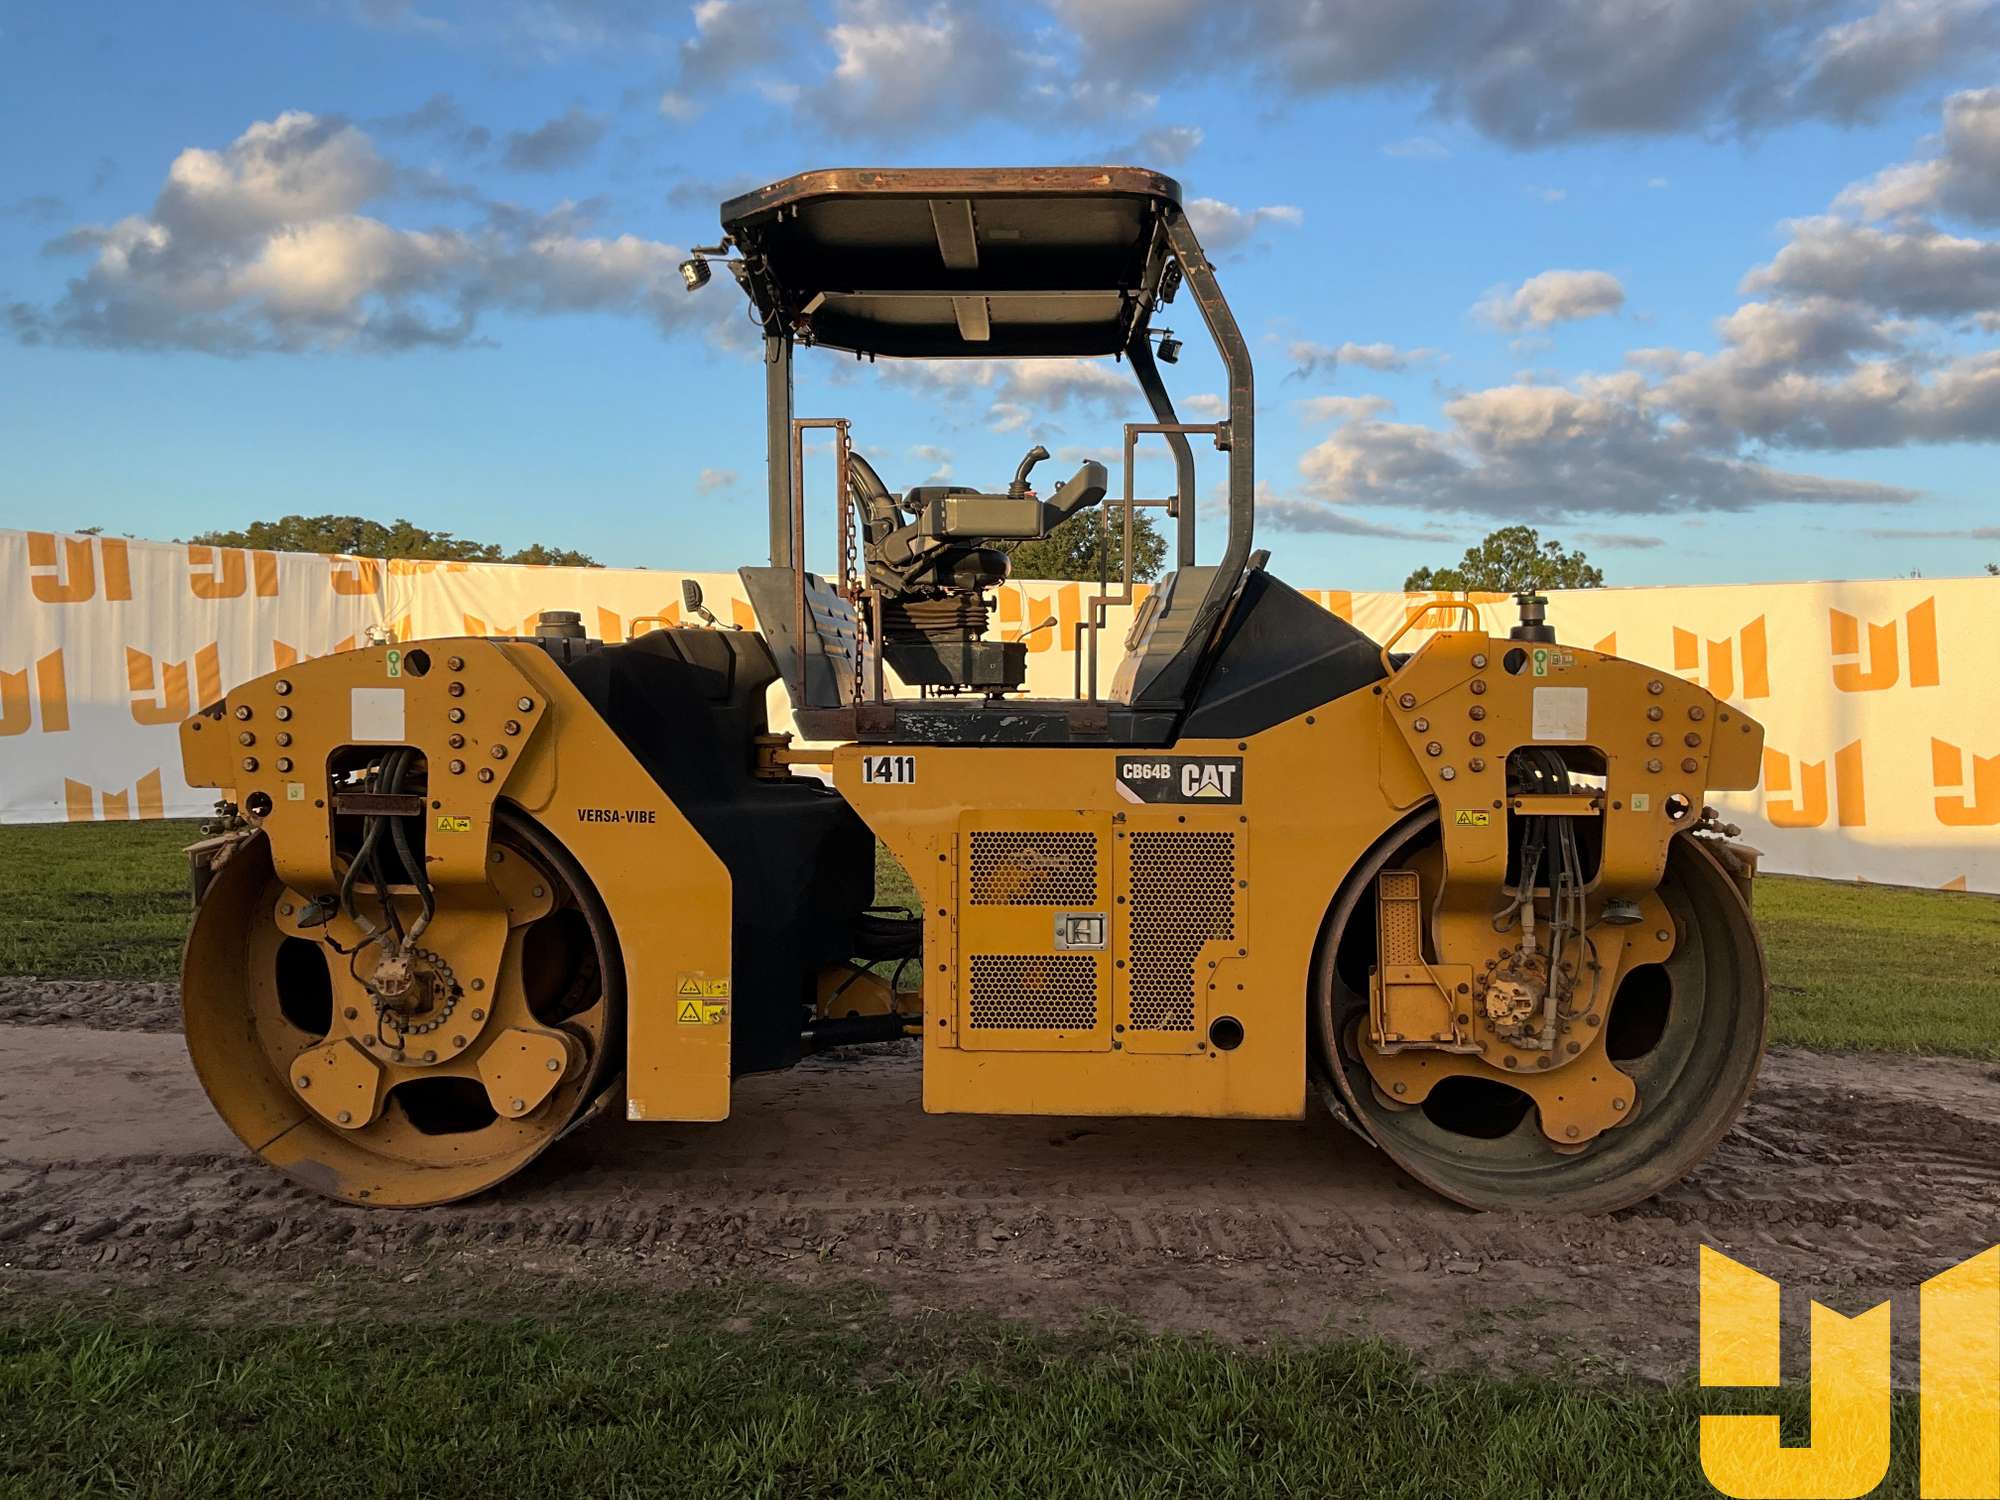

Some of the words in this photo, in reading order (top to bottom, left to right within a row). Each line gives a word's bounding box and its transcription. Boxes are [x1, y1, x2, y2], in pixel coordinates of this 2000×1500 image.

[863, 756, 915, 783] 1411
[1122, 763, 1171, 779] CB64B
[1181, 763, 1236, 798] CAT
[577, 808, 656, 824] VERSA-VIBE
